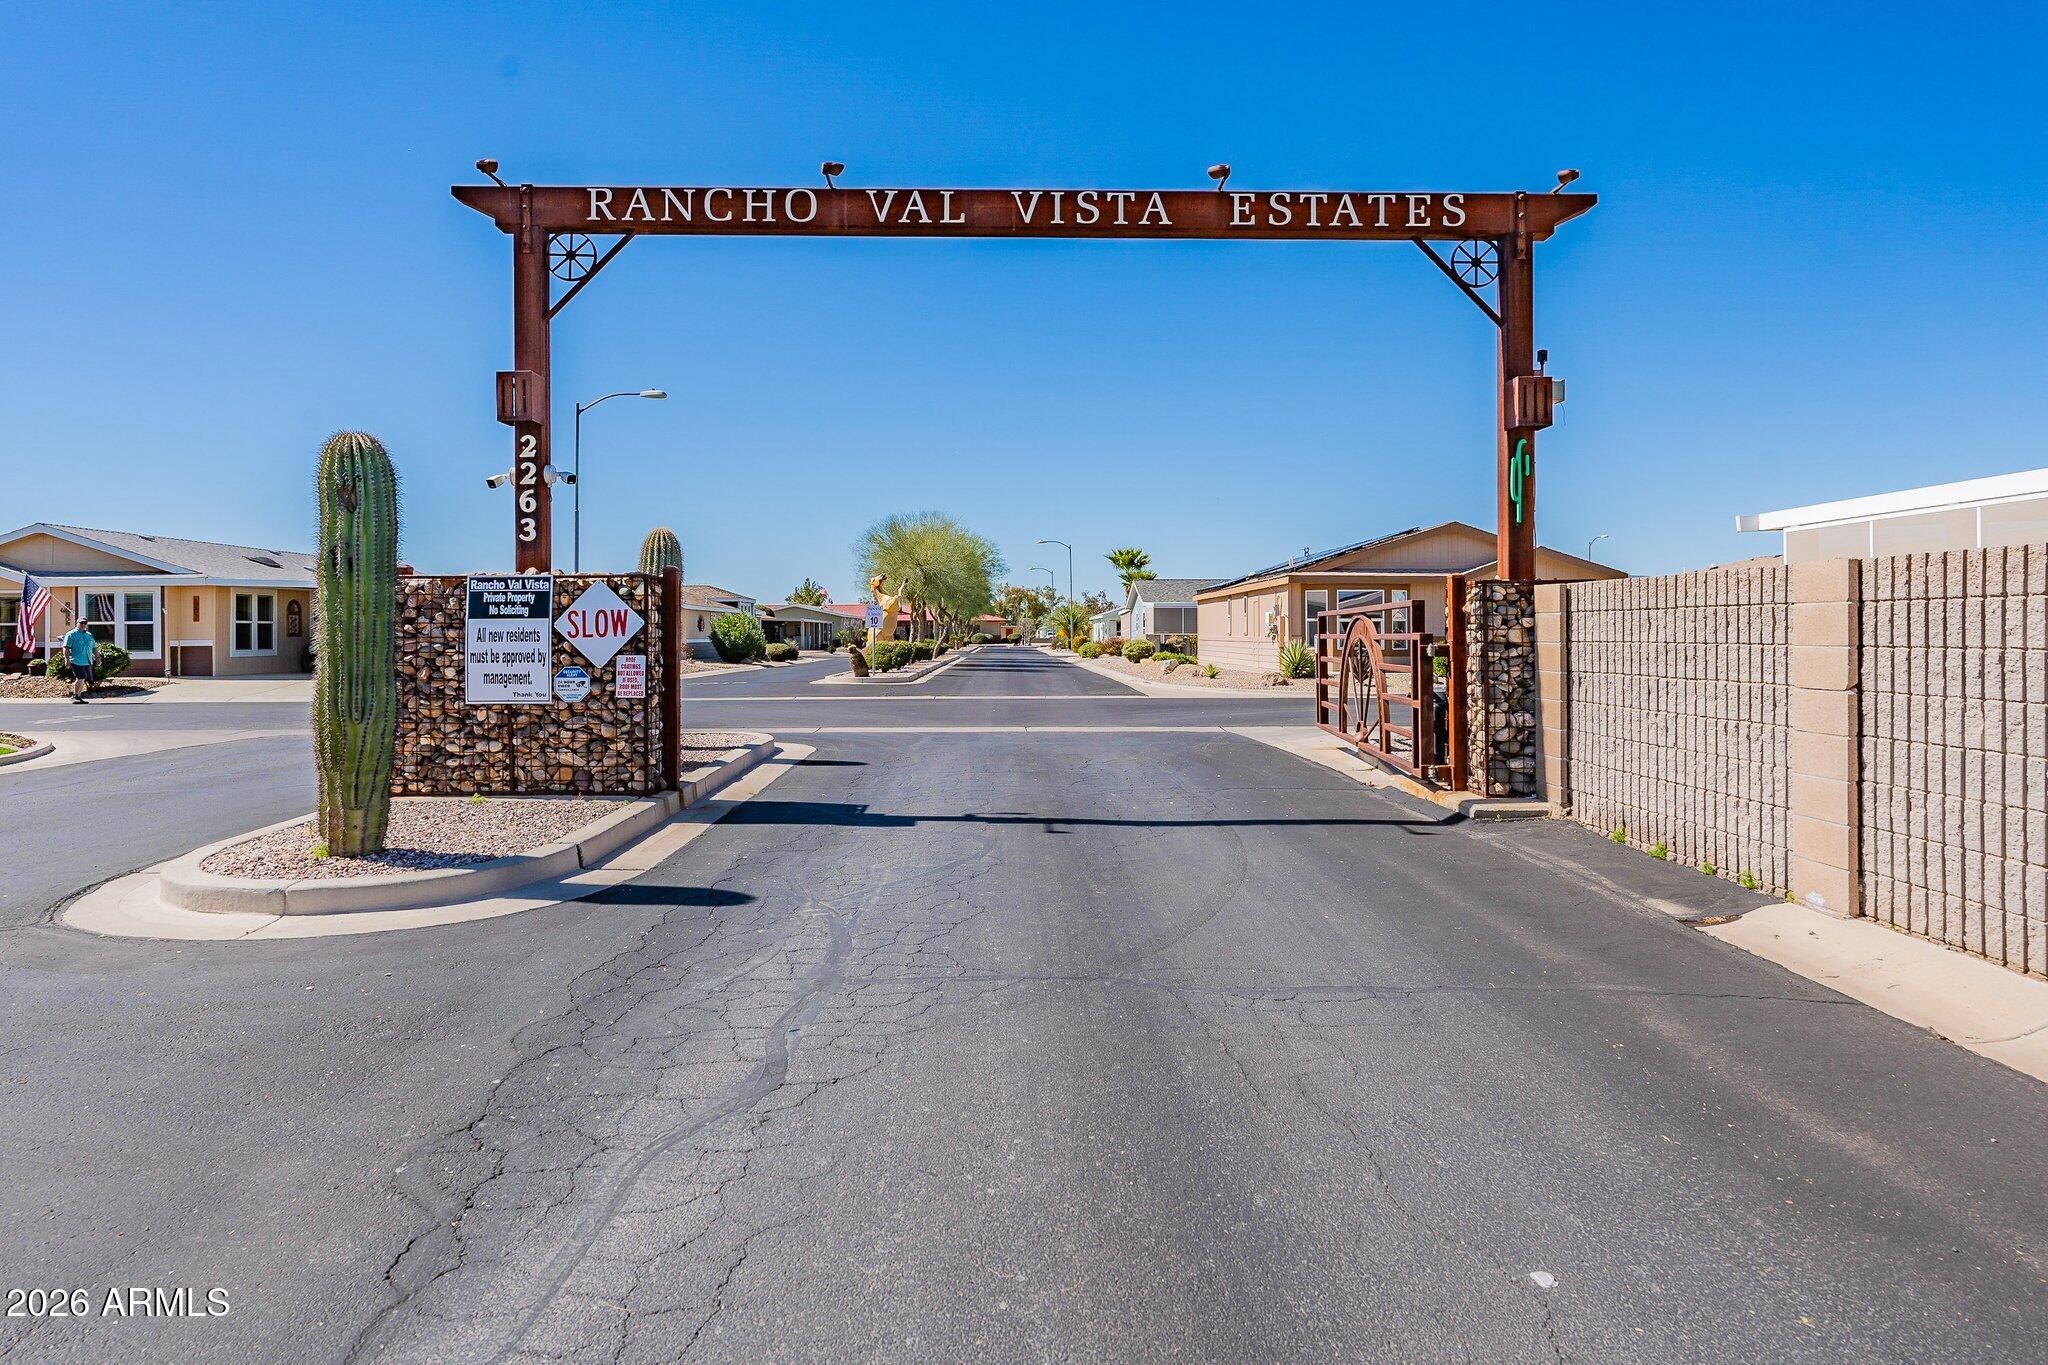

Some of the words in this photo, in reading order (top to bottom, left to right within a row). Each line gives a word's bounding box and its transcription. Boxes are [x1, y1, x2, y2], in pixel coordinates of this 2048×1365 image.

[586, 187, 819, 223] RANCHO
[866, 190, 966, 224] VAL
[1011, 191, 1173, 225] VISTA
[1229, 193, 1467, 227] ESTATES
[519, 434, 537, 542] 2263
[470, 579, 506, 590] Rancho
[507, 579, 523, 590] Val
[524, 579, 550, 590] Vista
[483, 592, 506, 603] Private
[507, 592, 536, 604] Property
[489, 604, 499, 615] No
[499, 604, 529, 617] Soliciting
[567, 609, 628, 638] SLOW
[870, 617, 878, 625] 10
[476, 627, 487, 642] All
[488, 630, 505, 642] new
[506, 627, 541, 642] residents
[470, 649, 489, 664] must
[490, 648, 500, 663] be
[502, 648, 536, 667] approved
[537, 648, 547, 667] by
[483, 671, 533, 688] management.
